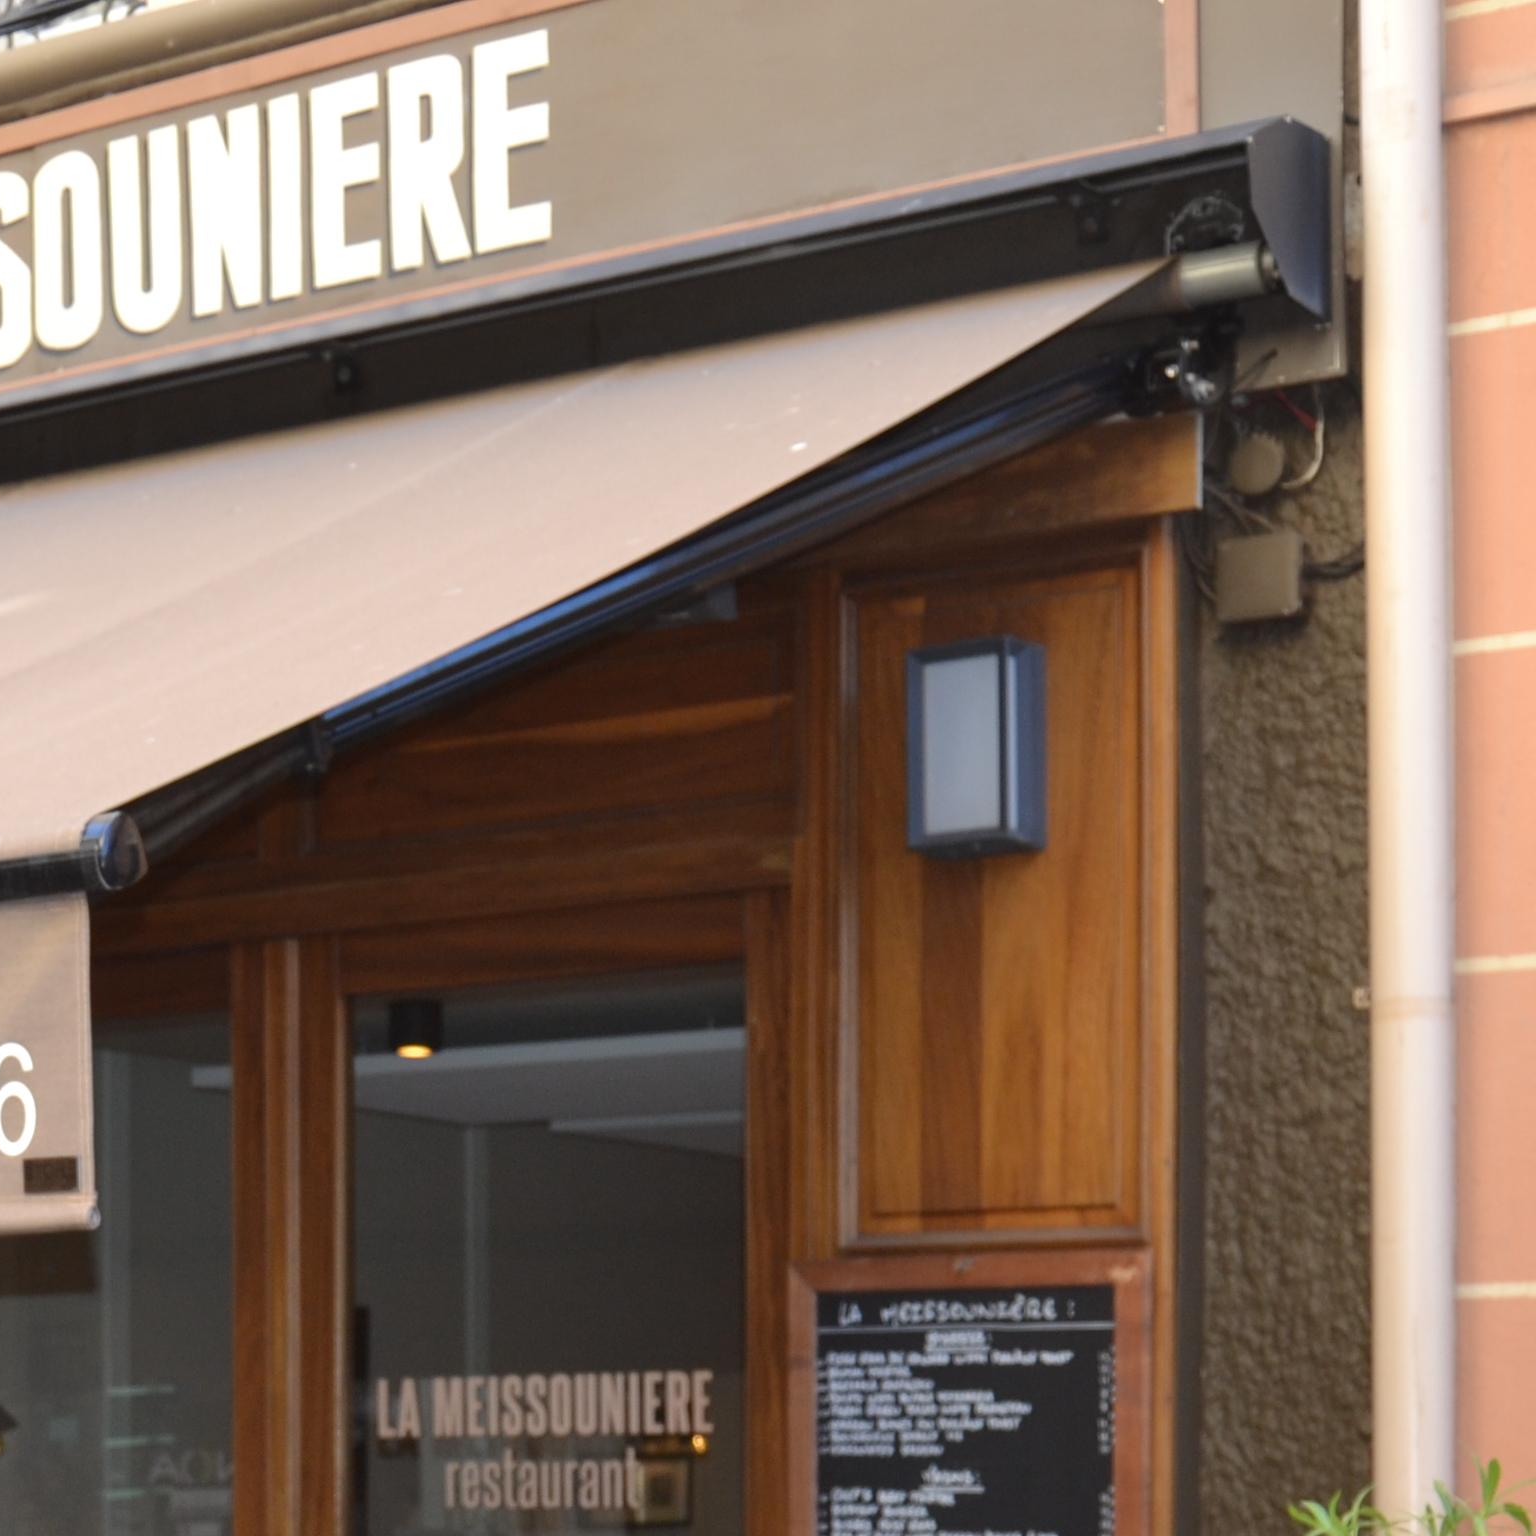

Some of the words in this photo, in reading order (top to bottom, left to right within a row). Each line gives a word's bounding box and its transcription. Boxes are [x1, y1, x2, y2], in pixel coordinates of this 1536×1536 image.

[376, 1376, 422, 1440] LA
[432, 1369, 714, 1439] MEISSOUNIERE
[444, 1447, 642, 1511] restaurant
